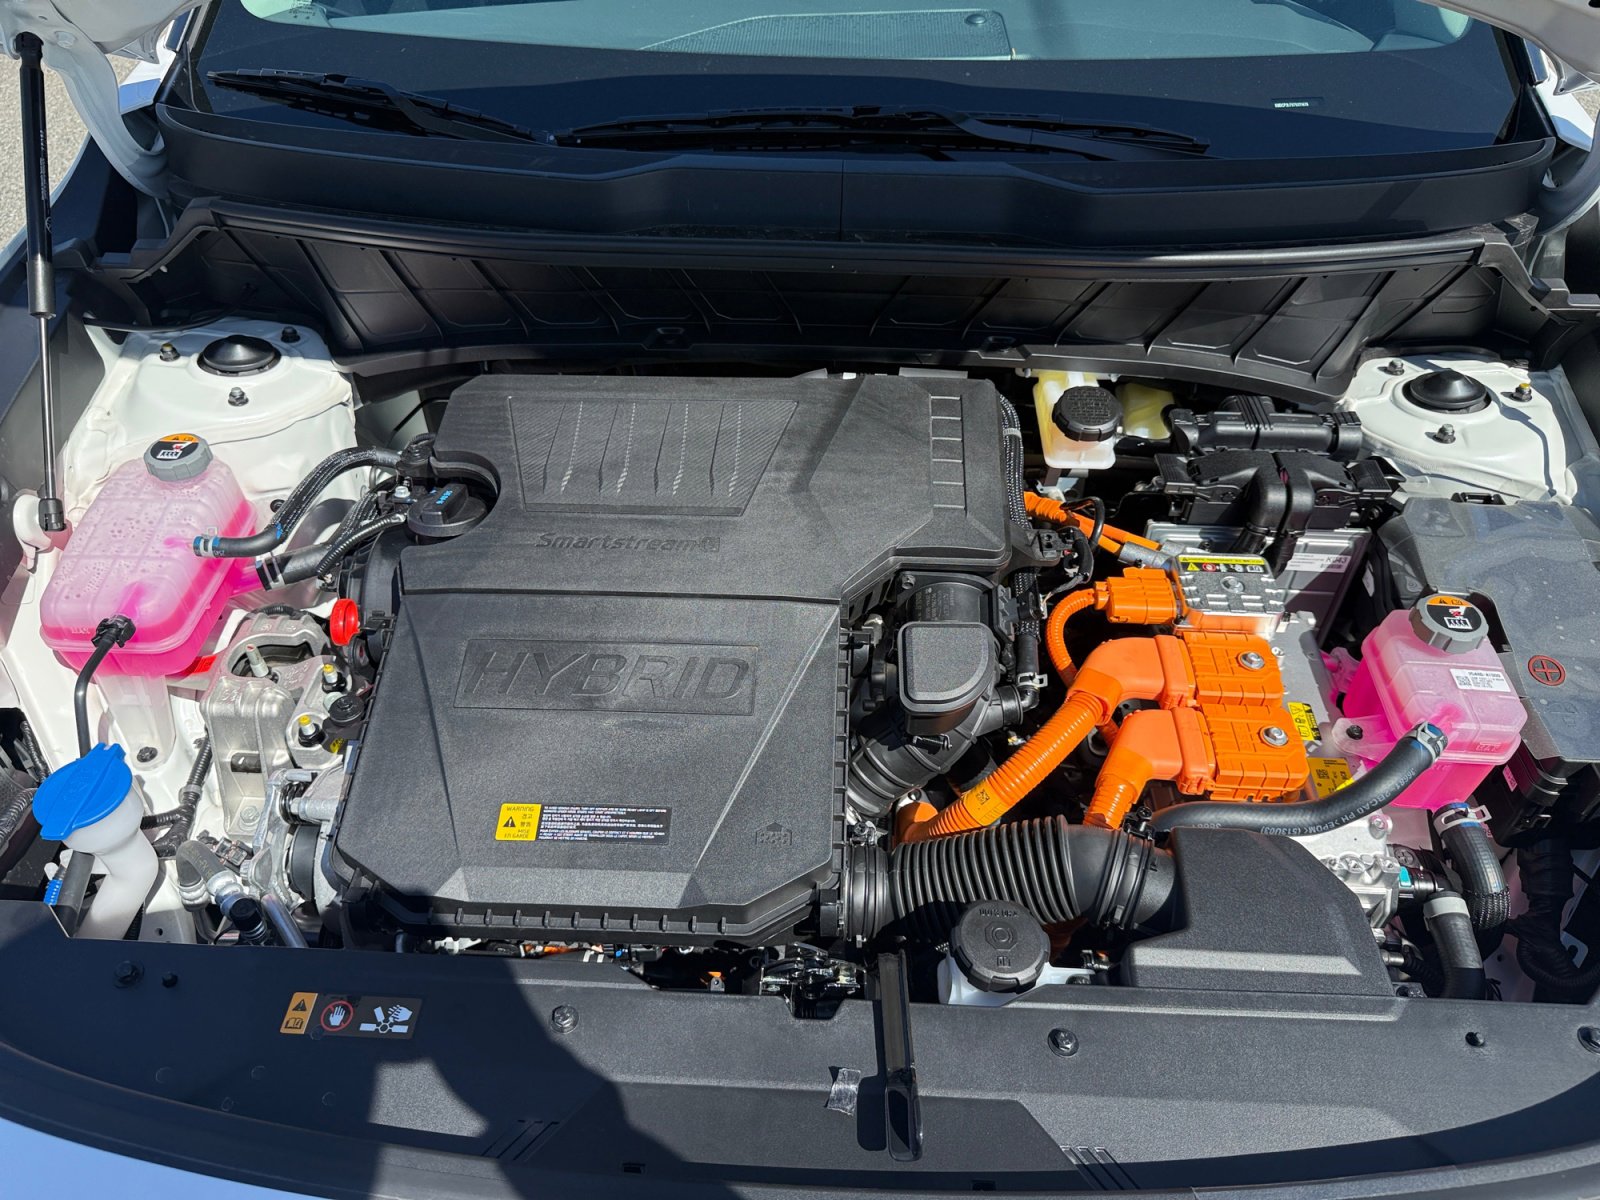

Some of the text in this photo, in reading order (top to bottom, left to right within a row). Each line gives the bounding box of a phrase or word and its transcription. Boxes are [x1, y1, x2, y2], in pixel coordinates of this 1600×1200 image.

[535, 532, 700, 550] Smartstream
[464, 652, 749, 699] HYBRID
[1341, 810, 1356, 824] PH
